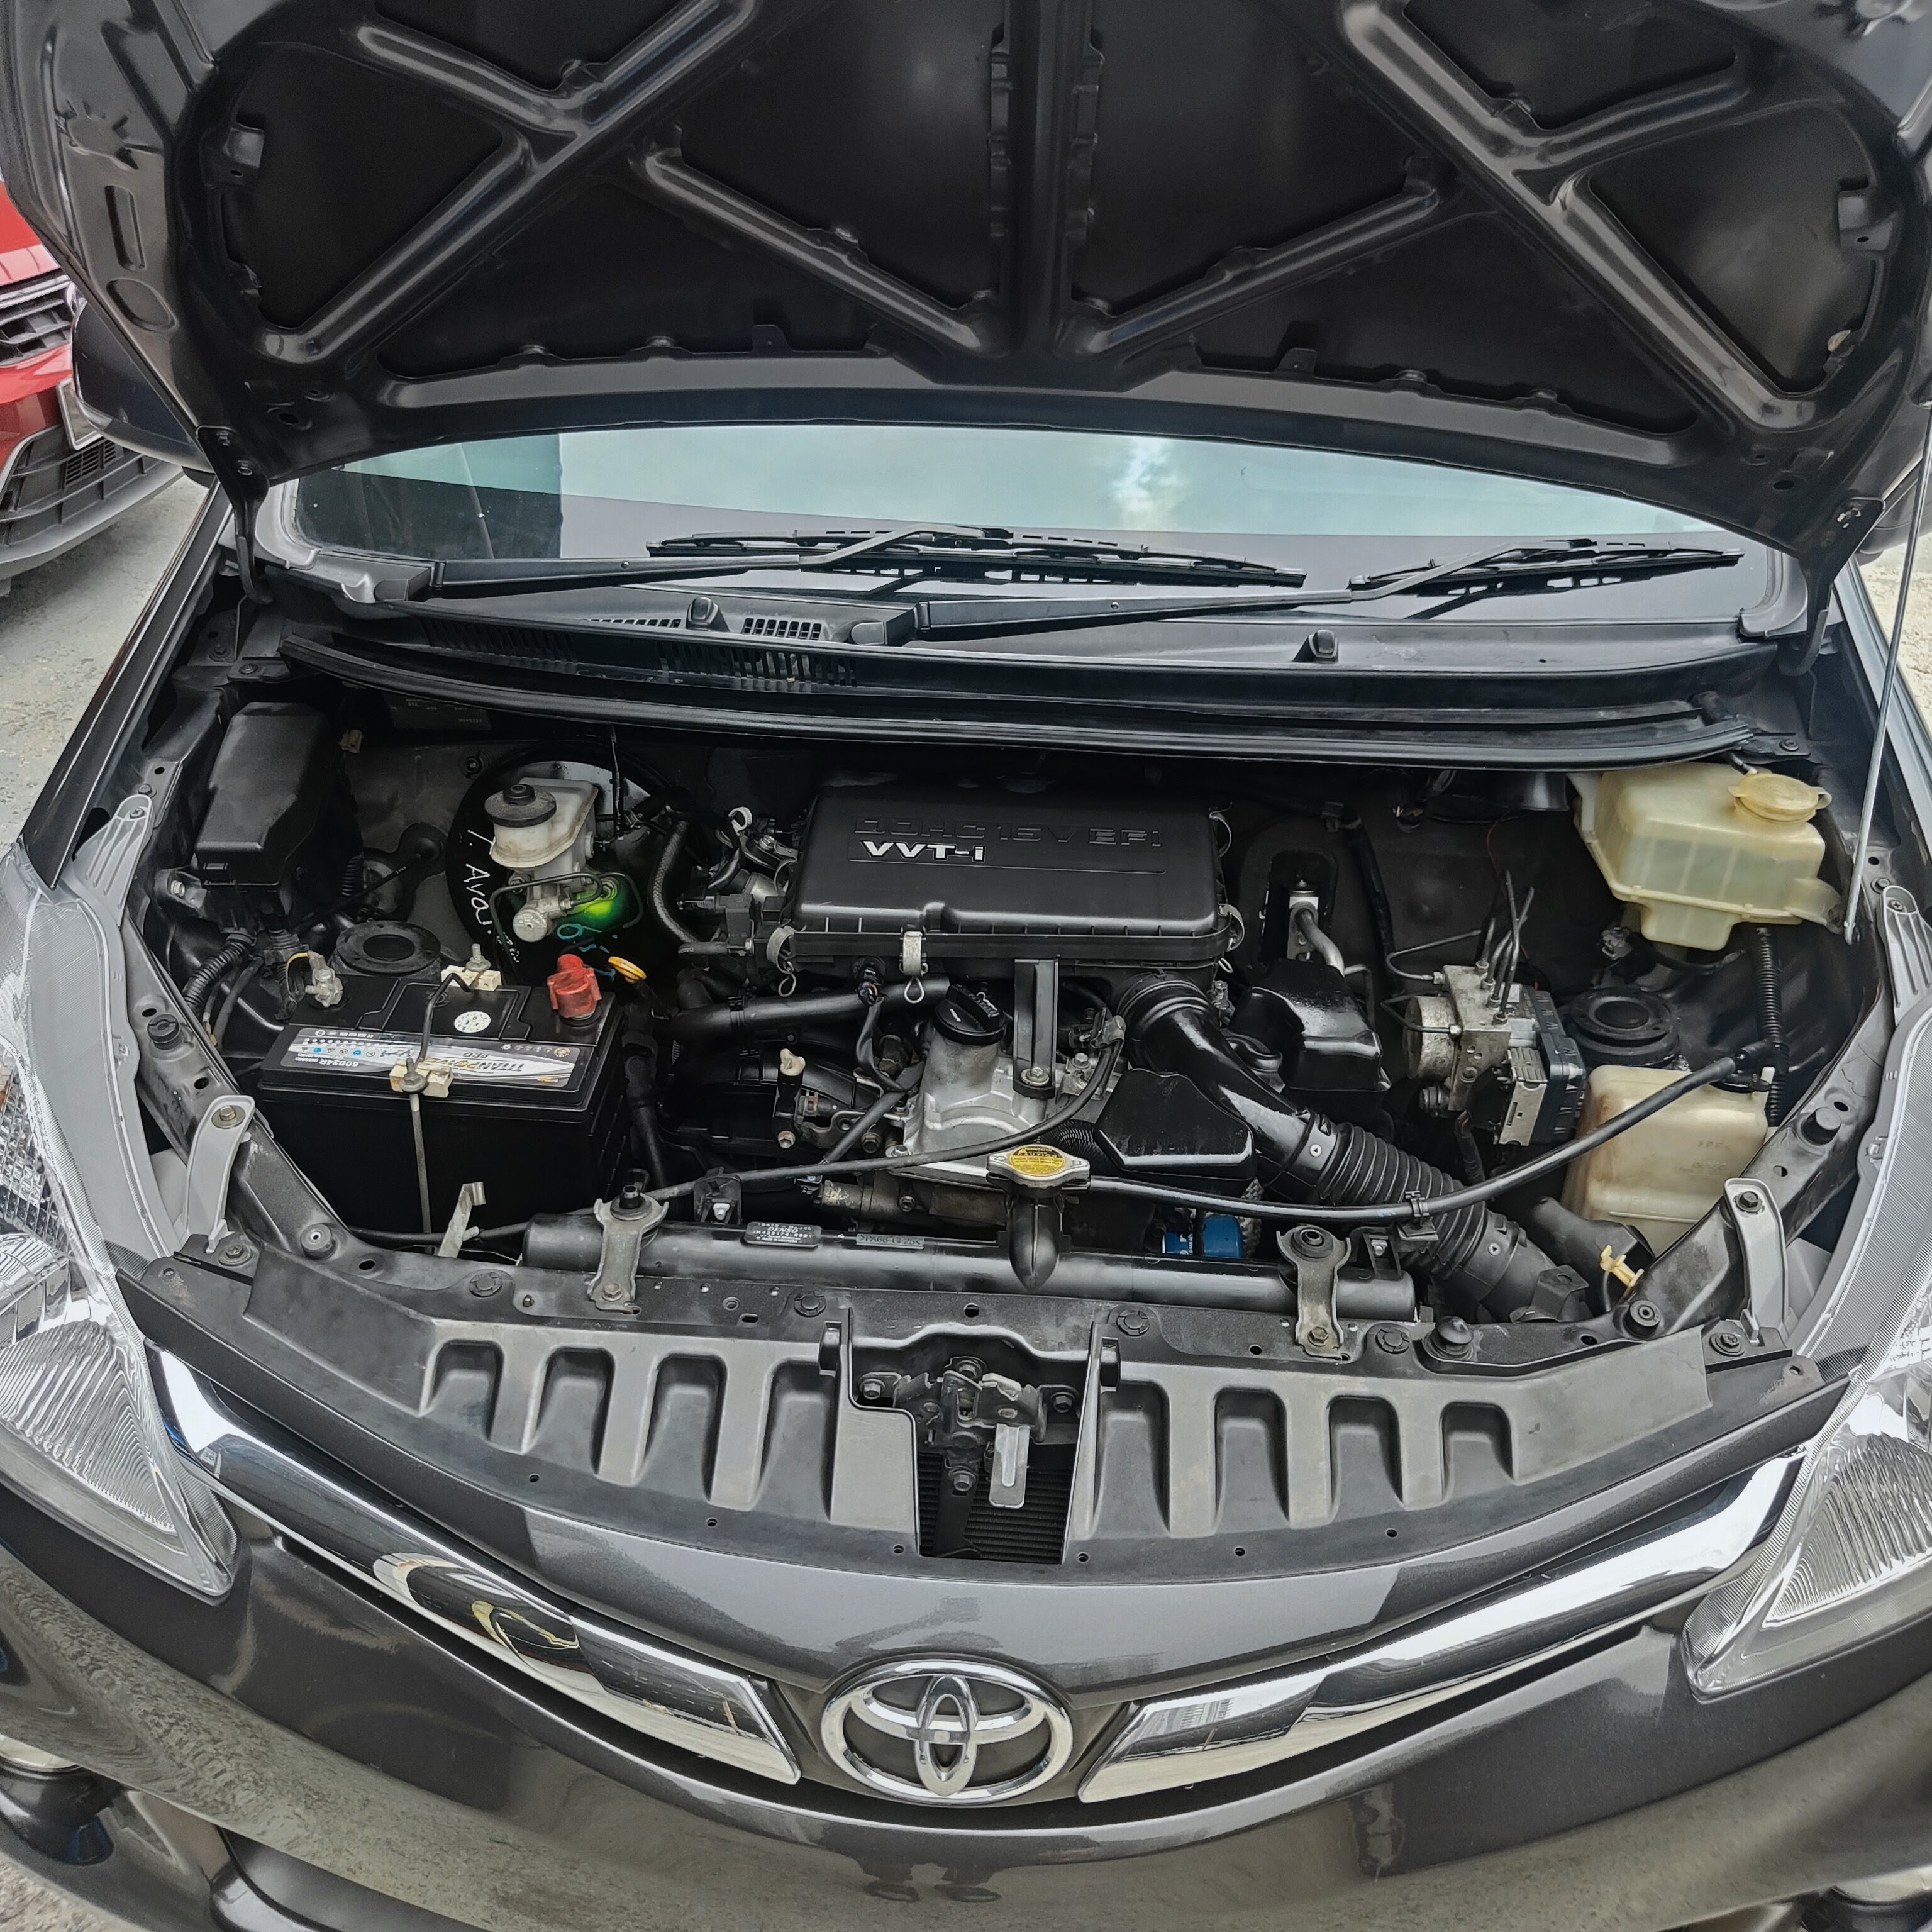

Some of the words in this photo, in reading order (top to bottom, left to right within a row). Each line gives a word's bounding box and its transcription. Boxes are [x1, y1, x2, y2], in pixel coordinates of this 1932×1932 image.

[1089, 828, 1161, 847] EFI
[862, 840, 984, 862] VVT-i
[424, 1058, 525, 1072] TITANPOWE
